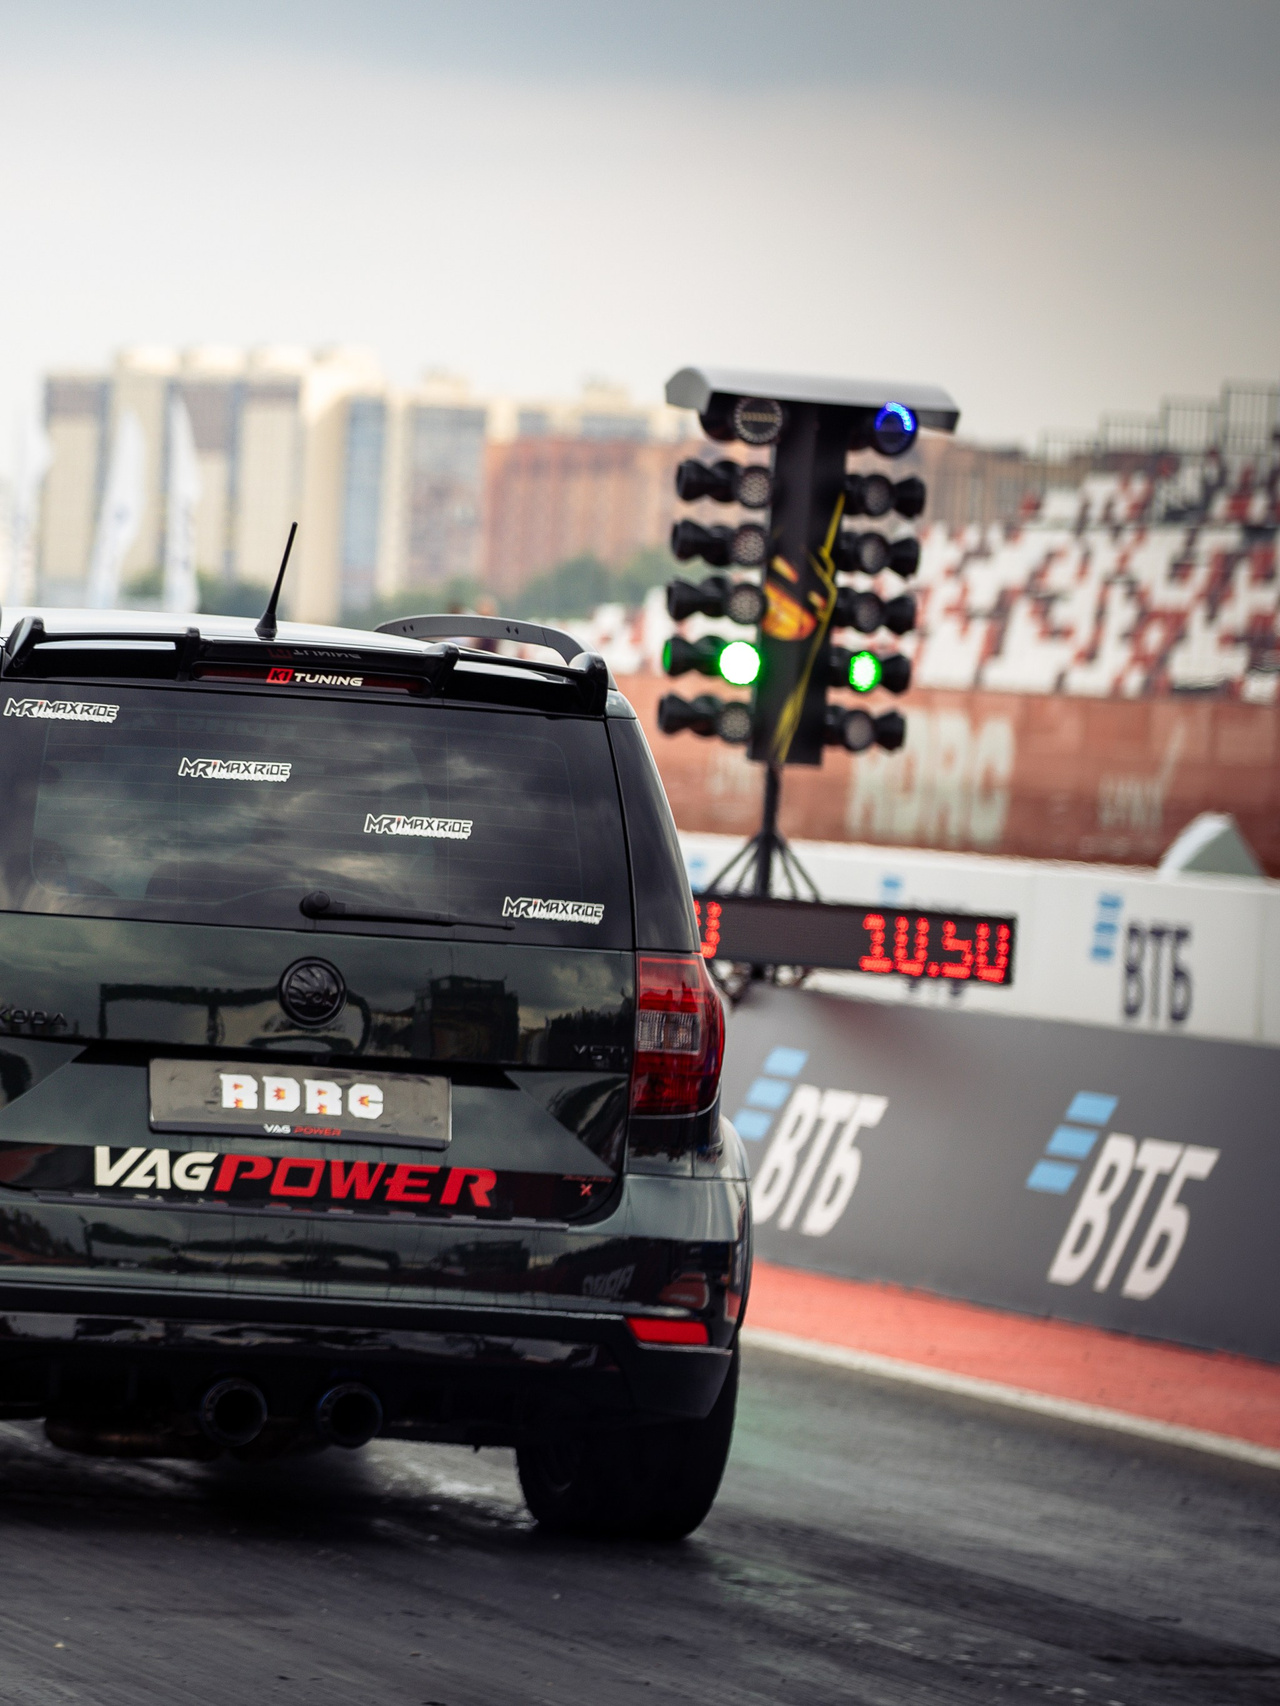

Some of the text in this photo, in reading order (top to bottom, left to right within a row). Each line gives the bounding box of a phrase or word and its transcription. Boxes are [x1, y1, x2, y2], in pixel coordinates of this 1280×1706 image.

[294, 673, 364, 687] TUNING
[1124, 920, 1193, 1022] ВТБ
[219, 1073, 384, 1120] RDRC
[293, 1125, 342, 1136] POWER
[751, 1083, 890, 1238] ВТБ
[1047, 1131, 1221, 1301] ВТБ
